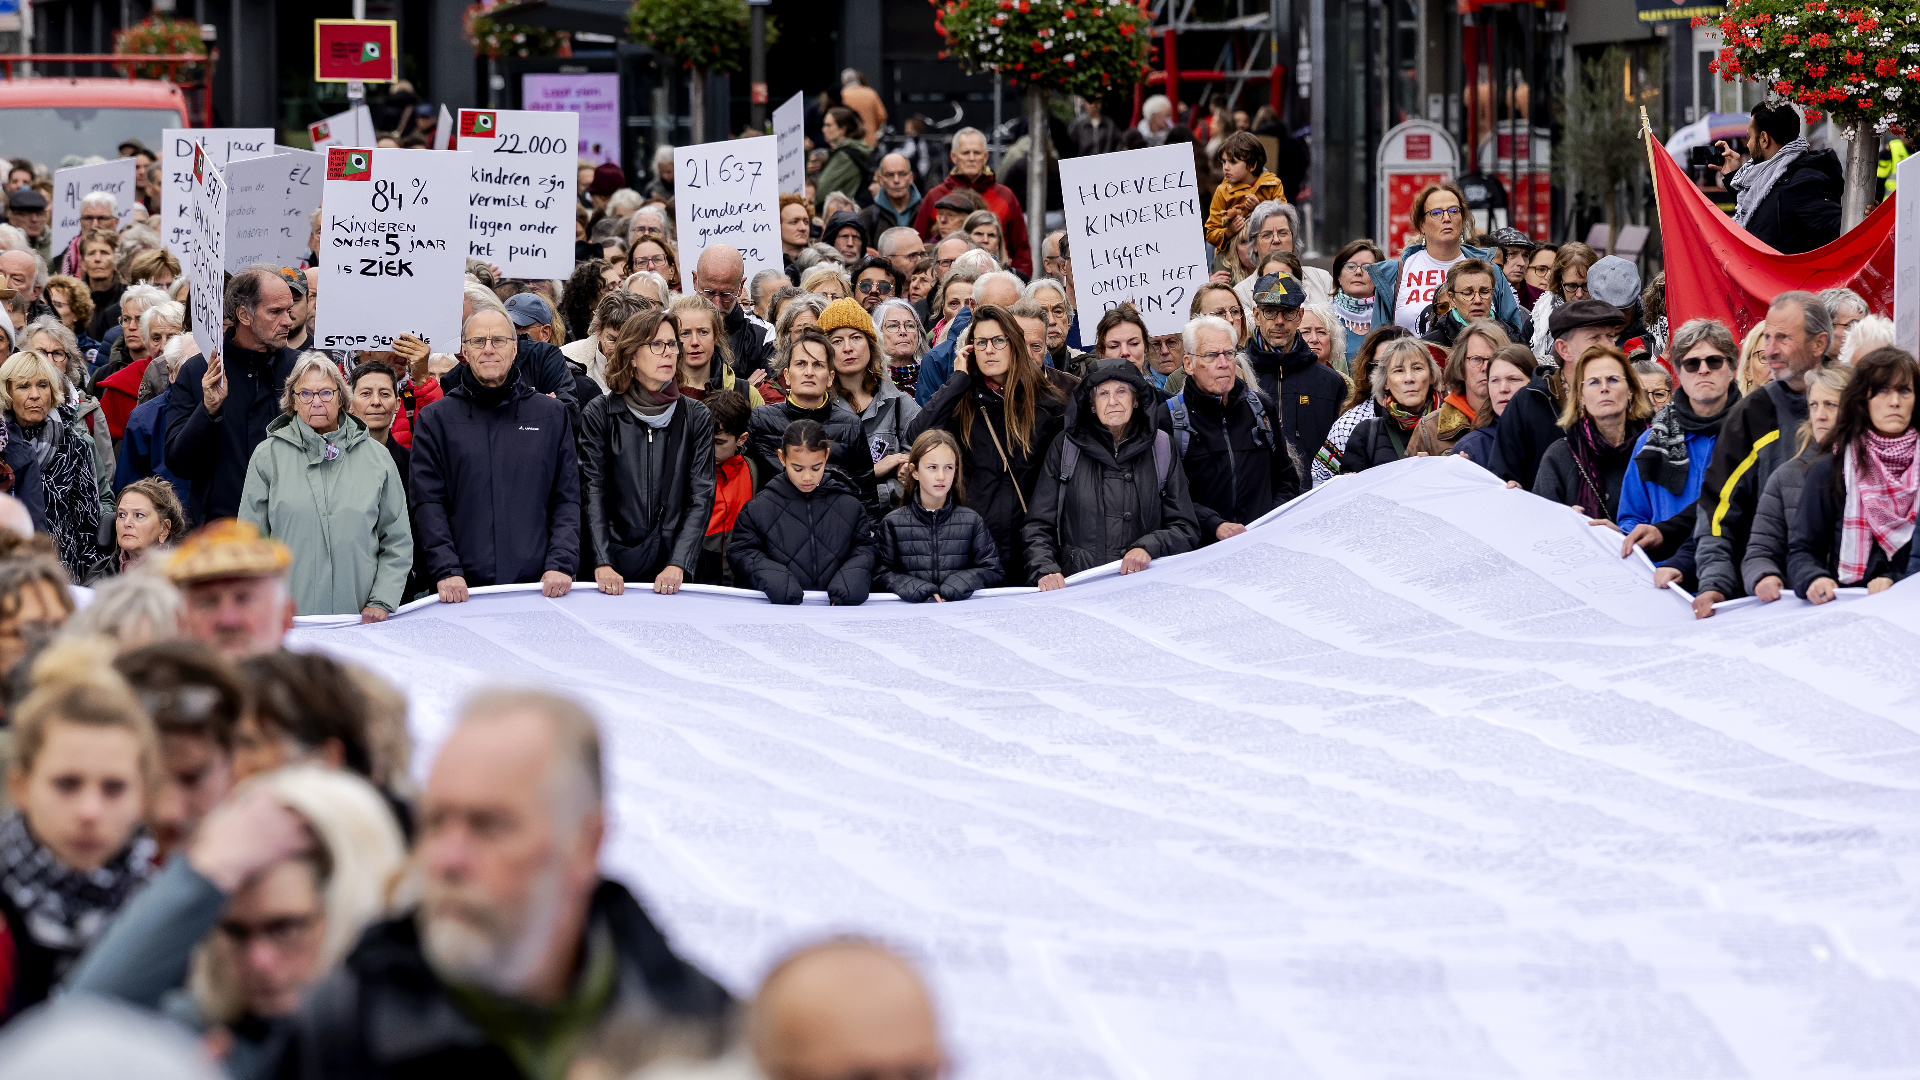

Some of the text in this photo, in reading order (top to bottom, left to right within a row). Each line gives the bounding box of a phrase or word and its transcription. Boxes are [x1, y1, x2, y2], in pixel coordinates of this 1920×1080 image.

[227, 136, 266, 163] jaar
[494, 133, 567, 154] 22.000
[686, 154, 763, 195] 21.637
[1078, 170, 1193, 206] HOEVEEL
[371, 178, 428, 212] 84 %
[535, 196, 555, 209] of
[469, 213, 560, 238] liggen onder
[1085, 198, 1194, 237] KINDEREN
[385, 233, 401, 256] 5
[696, 218, 772, 248] gedood in
[469, 240, 547, 262] het puin
[1091, 264, 1199, 296] ONDER HET
[1102, 286, 1185, 315] PIN?
[324, 335, 367, 347] STOP
